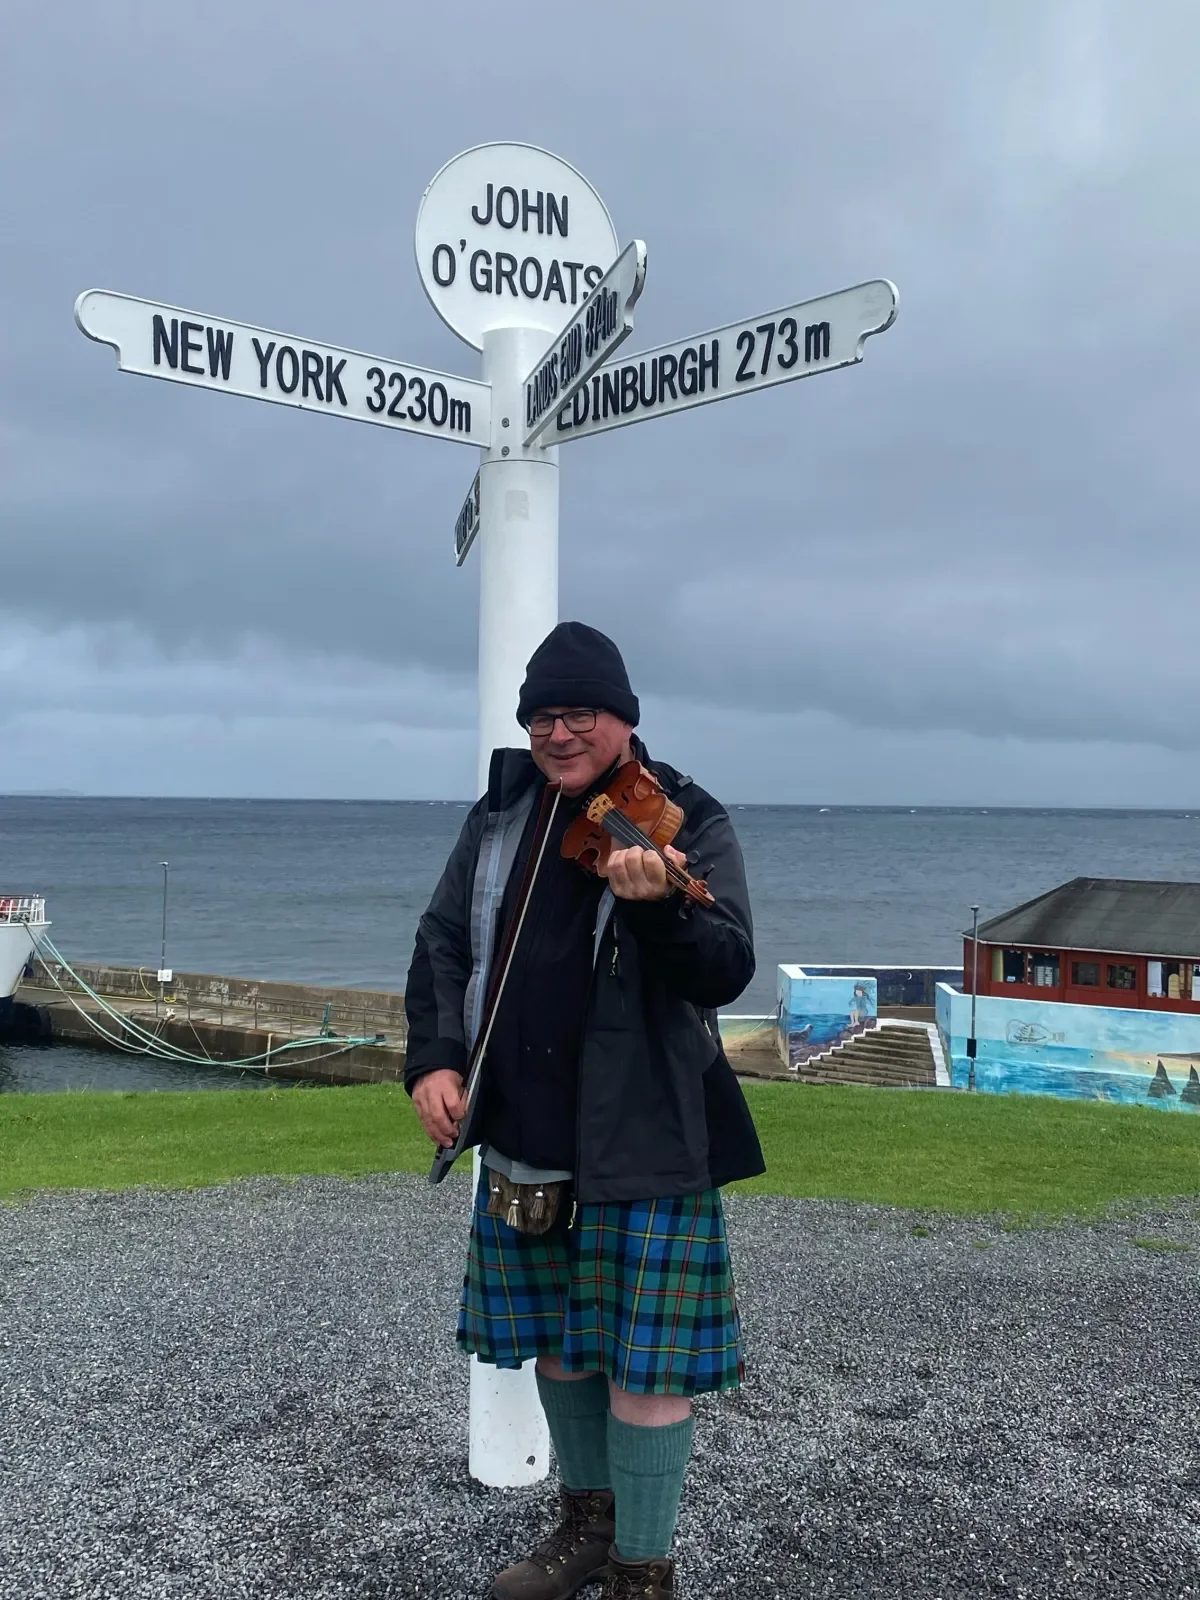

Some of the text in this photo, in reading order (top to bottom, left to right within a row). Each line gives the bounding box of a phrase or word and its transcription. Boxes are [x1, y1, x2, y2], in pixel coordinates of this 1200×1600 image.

[471, 183, 568, 237] JOHN
[432, 239, 604, 304] O'GROATS
[152, 314, 471, 433] NEW YORK 3230m
[556, 317, 830, 431] EDINBURGH 273m
[560, 323, 582, 390] END
